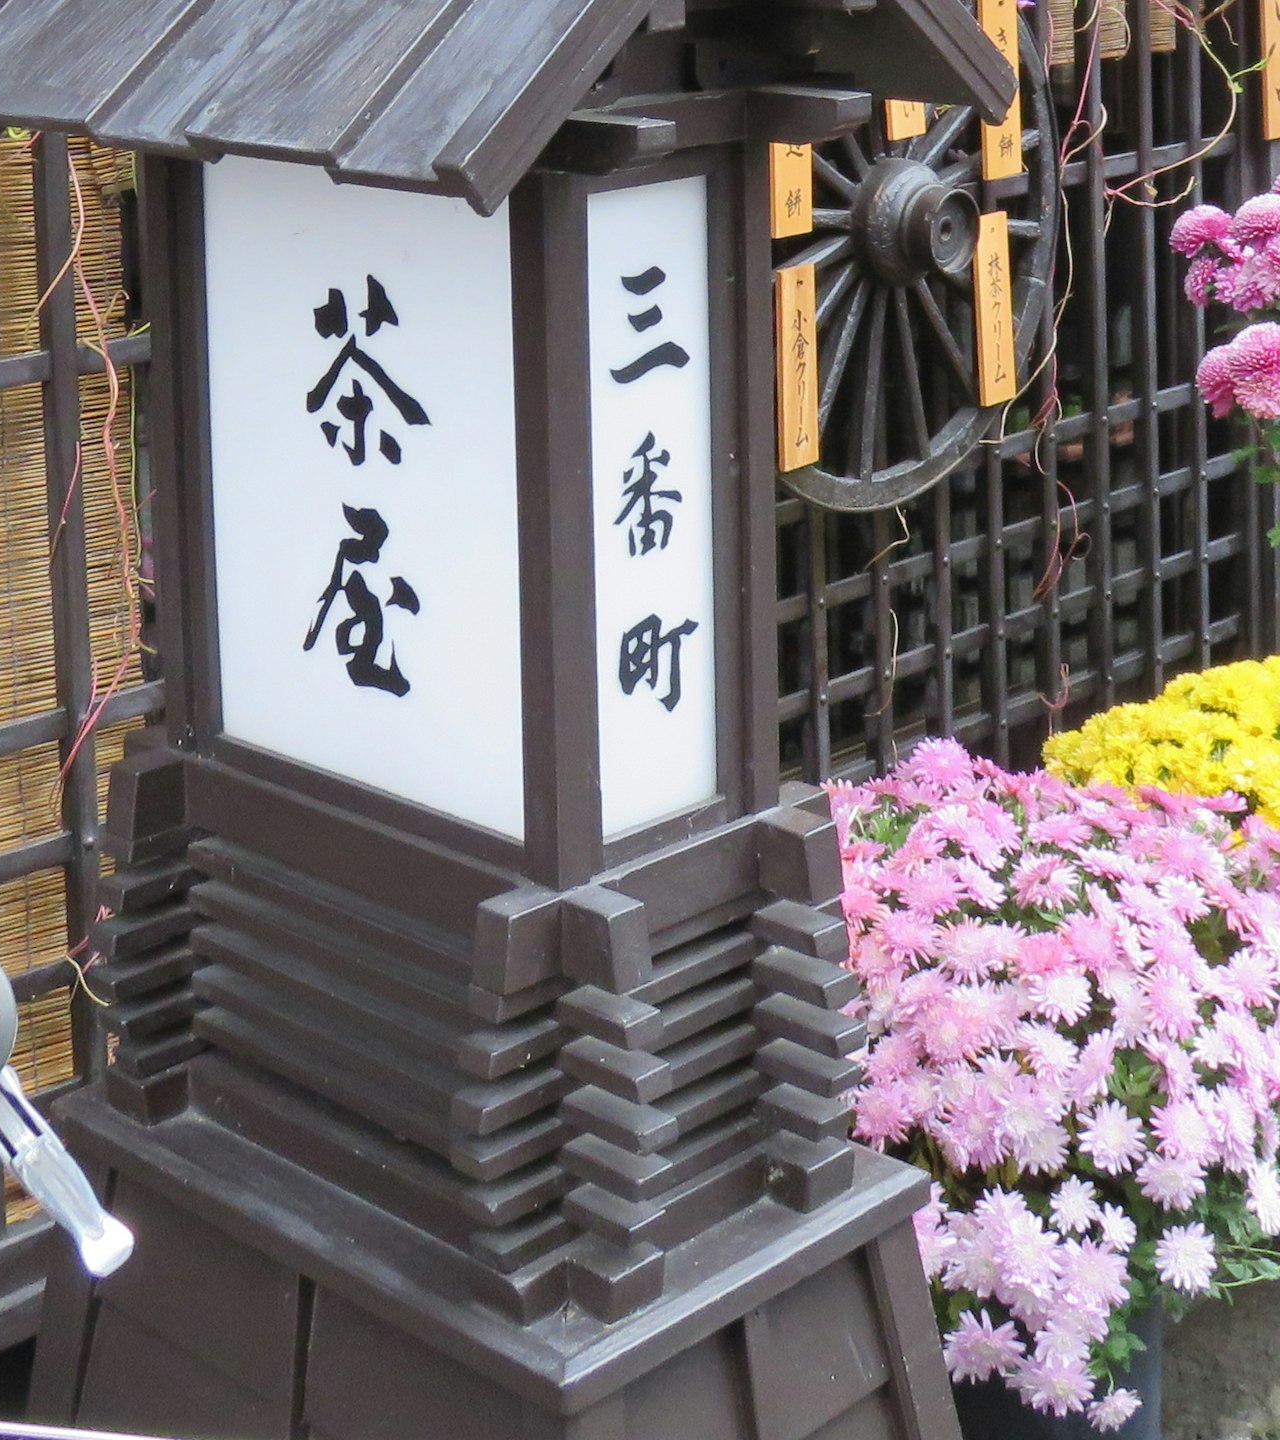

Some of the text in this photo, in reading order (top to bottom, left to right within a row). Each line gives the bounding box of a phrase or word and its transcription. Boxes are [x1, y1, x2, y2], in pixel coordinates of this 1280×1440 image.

[791, 310, 810, 448] 小倉クリーム
[987, 252, 1007, 383] 抹茶クリーム
[302, 274, 432, 697] 茶屋
[609, 265, 699, 712] 三番町
